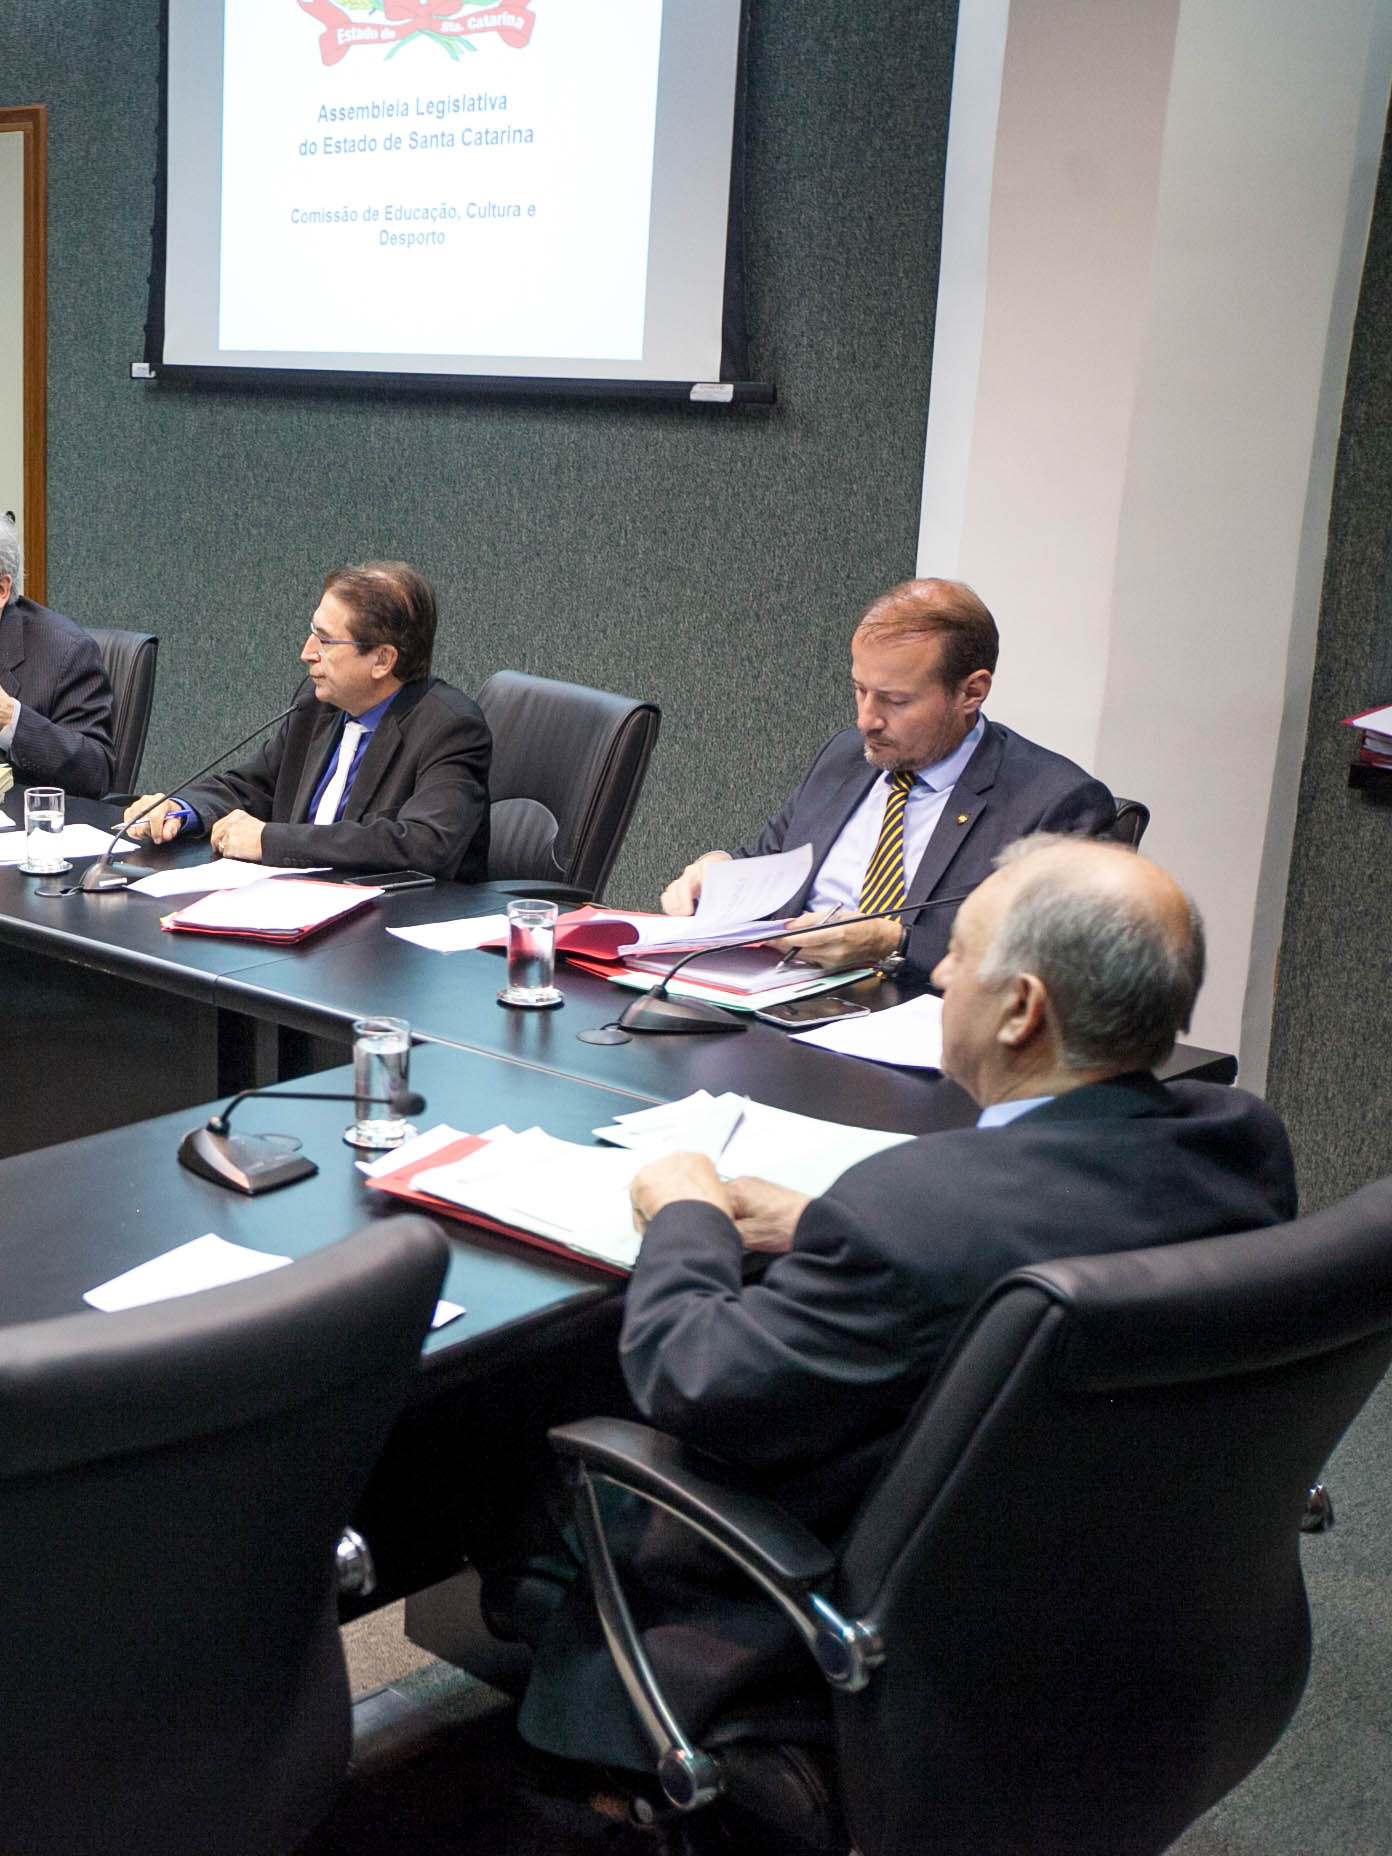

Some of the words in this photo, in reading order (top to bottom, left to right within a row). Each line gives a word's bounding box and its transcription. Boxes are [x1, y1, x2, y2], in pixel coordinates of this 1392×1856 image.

[466, 11, 525, 30] Catarina
[317, 100, 409, 123] Assembleia
[415, 92, 508, 120] Legislativa
[298, 138, 318, 157] do
[322, 134, 378, 155] Estado
[383, 132, 403, 151] de
[407, 130, 455, 150] Santa
[460, 125, 535, 147] Catarina
[290, 205, 358, 224] Comissão
[362, 205, 380, 222] de
[384, 202, 461, 223] Educação,
[466, 201, 522, 220] Cultura
[526, 203, 537, 217] e
[379, 229, 447, 249] Desporto
